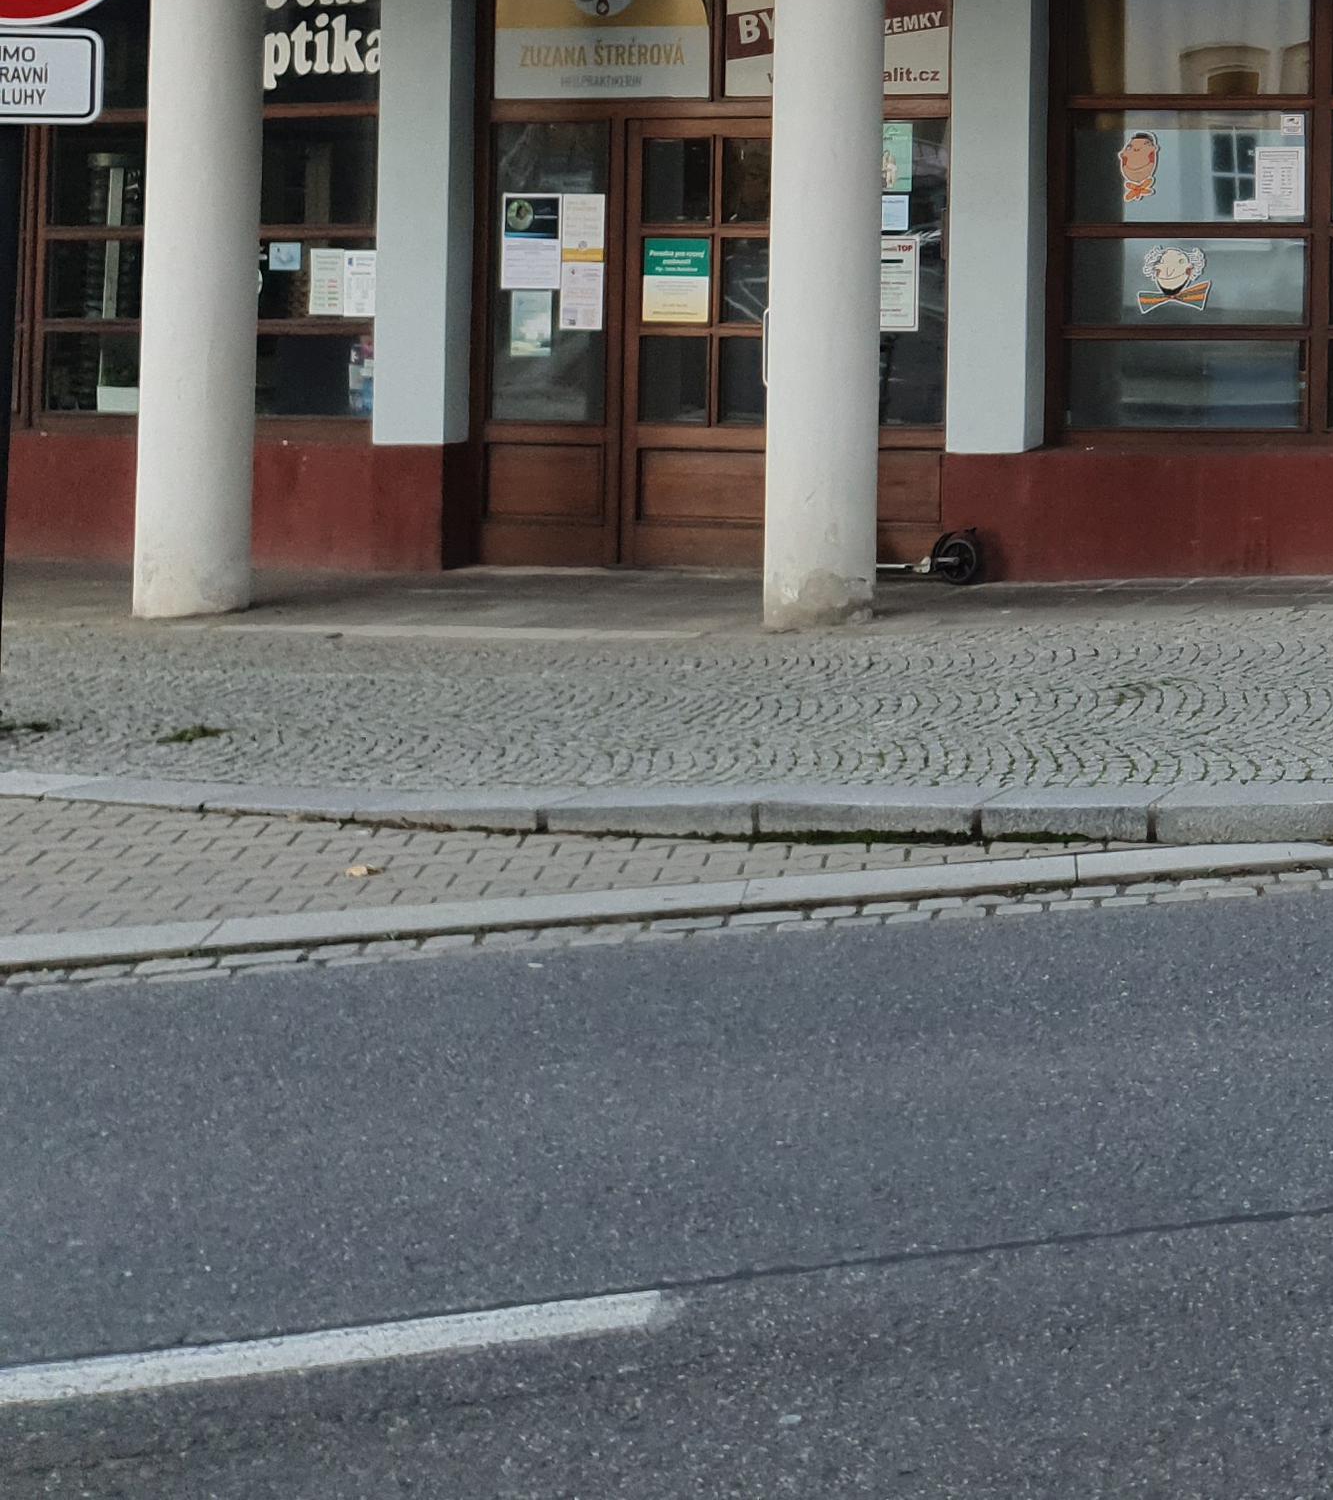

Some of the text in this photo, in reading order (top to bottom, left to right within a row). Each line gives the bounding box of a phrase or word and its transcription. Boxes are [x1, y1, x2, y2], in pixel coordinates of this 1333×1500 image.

[739, 11, 775, 45] BY
[884, 10, 943, 35] ZEMKY
[0, 46, 36, 62] MO
[264, 13, 381, 90] ptika
[520, 44, 587, 68] ZUZANA
[0, 62, 48, 84] RAVNÍ
[883, 67, 941, 82] alit.cz
[2, 88, 46, 105] LUHY
